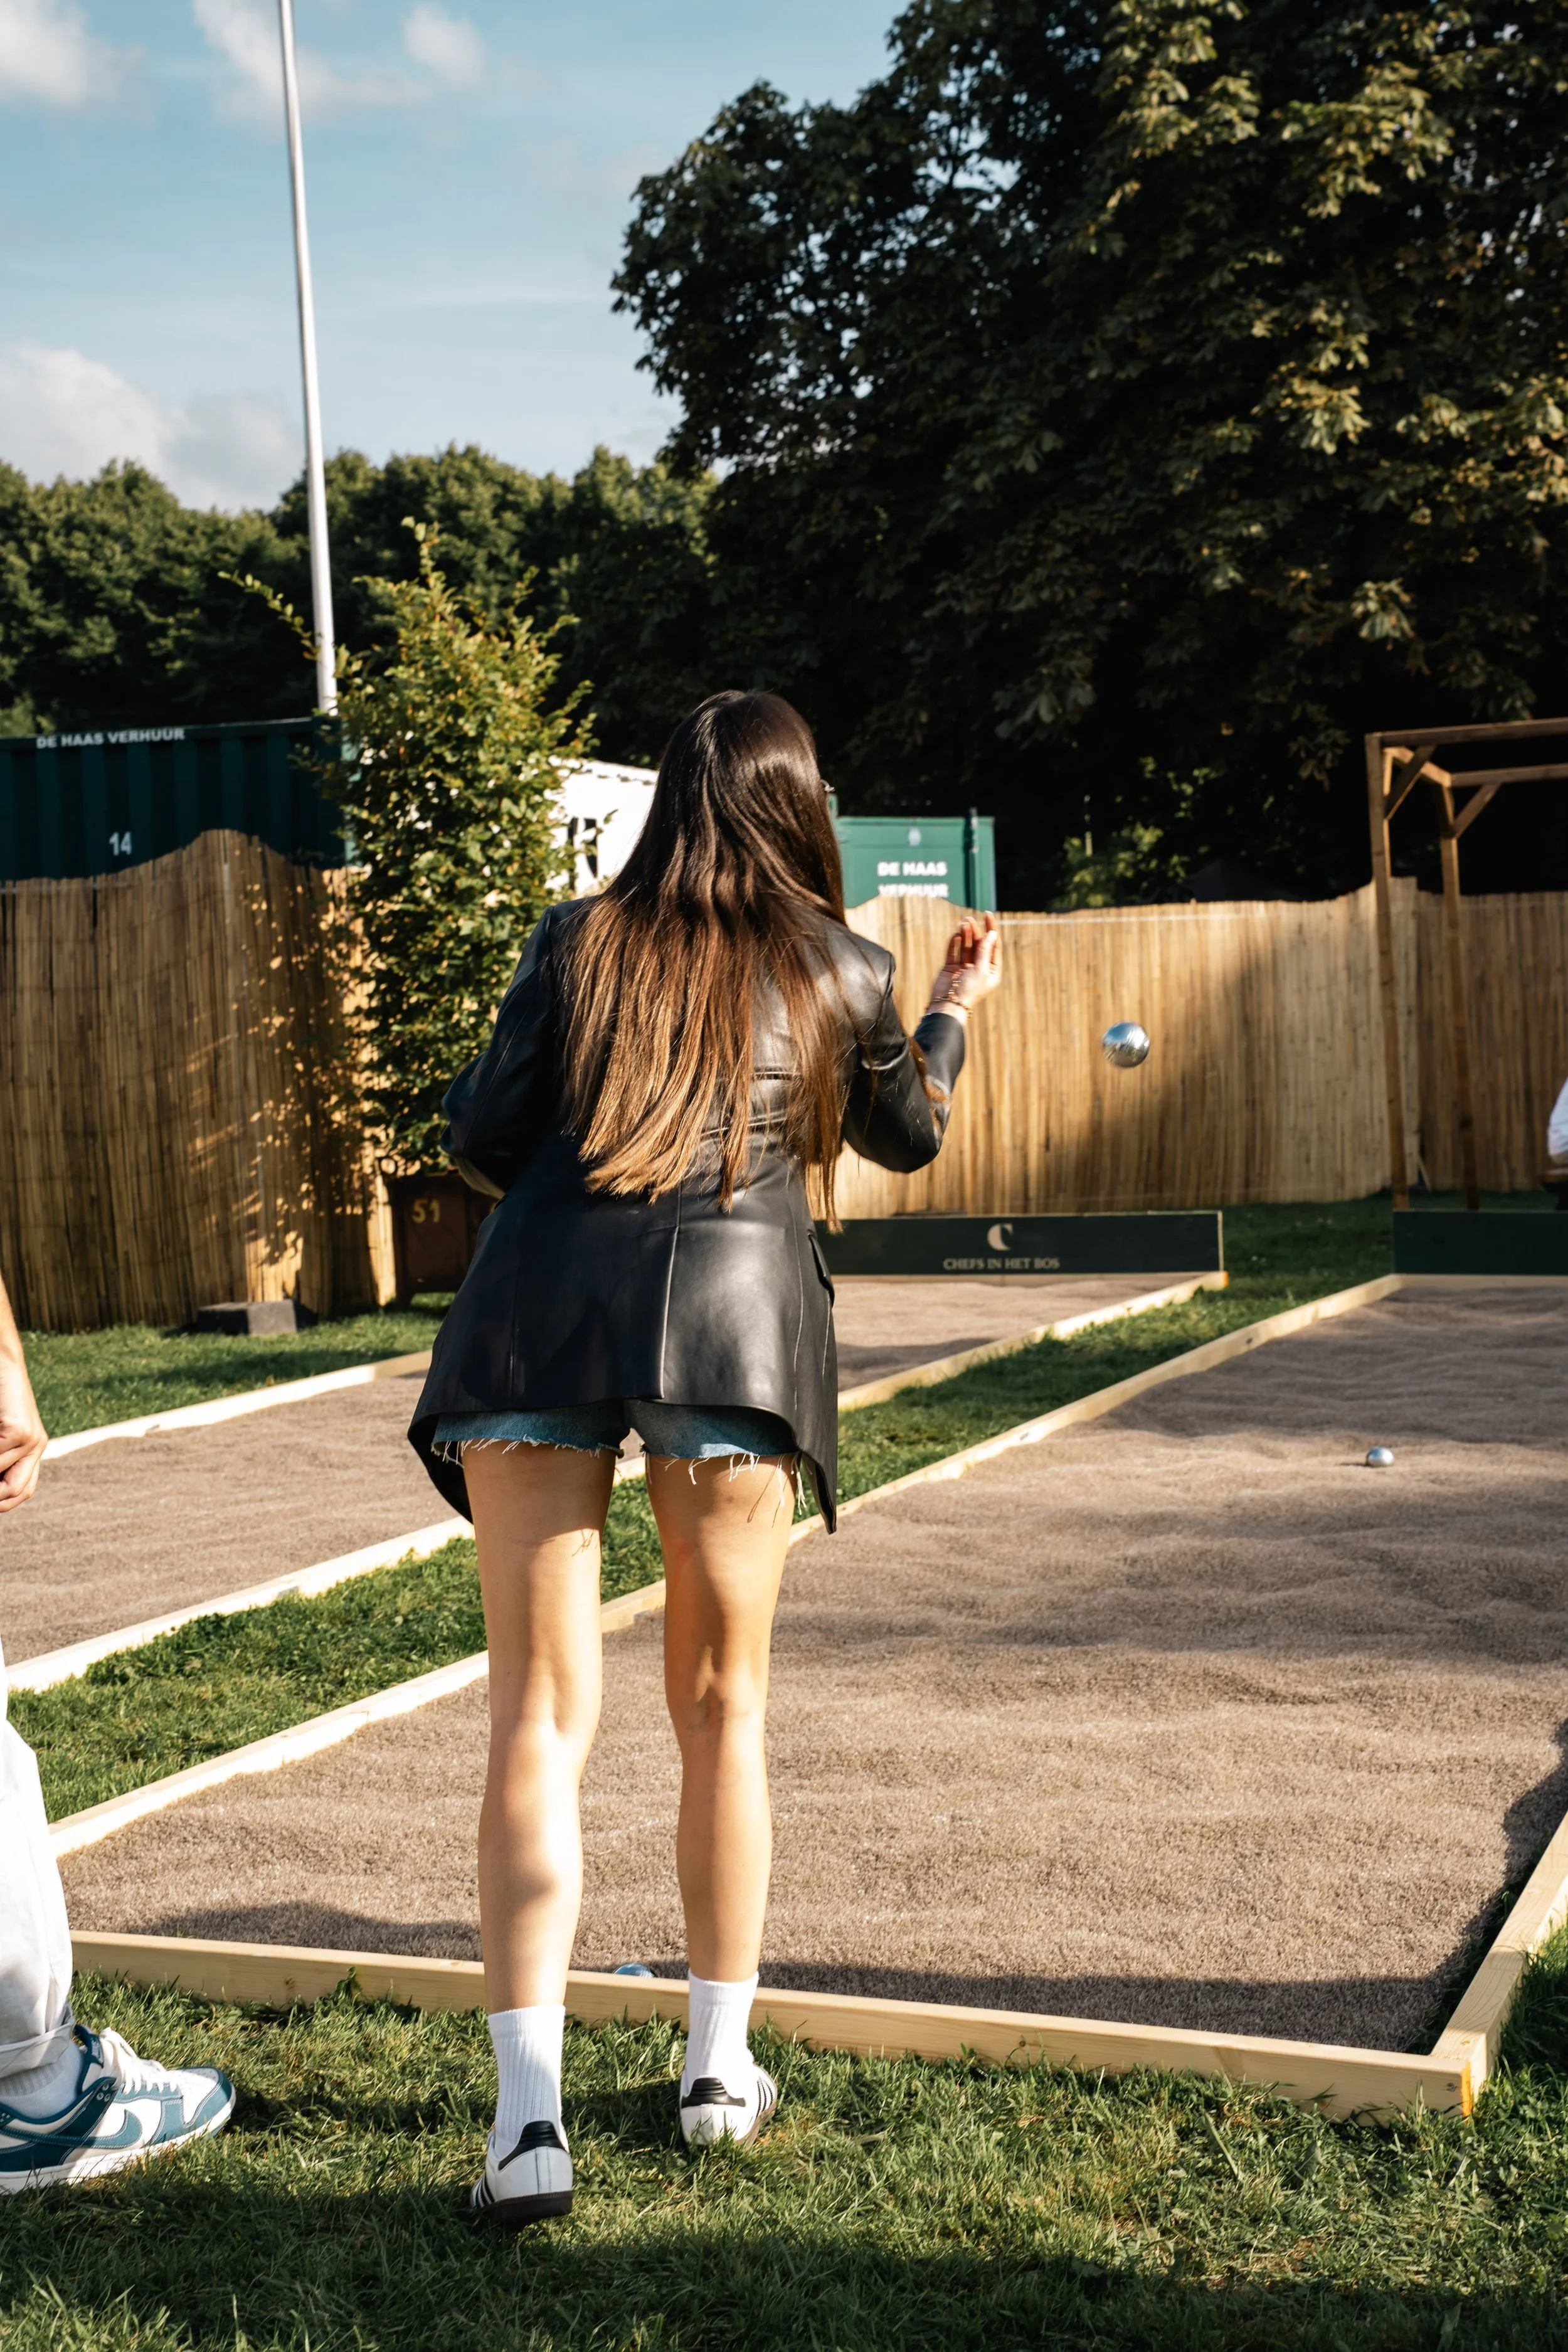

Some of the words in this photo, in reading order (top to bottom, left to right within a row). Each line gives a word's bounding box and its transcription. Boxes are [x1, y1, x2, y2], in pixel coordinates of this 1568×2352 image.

[36, 736, 57, 748] DE
[61, 733, 103, 747] HAAS
[108, 728, 185, 744] VERHUUR
[109, 832, 132, 856] 14
[877, 862, 900, 876] DE
[903, 861, 948, 876] HAAS
[411, 1198, 440, 1223] 51
[943, 1258, 984, 1270] CHEFS
[987, 1258, 1002, 1269] IN
[1005, 1258, 1032, 1269] HET
[1034, 1257, 1061, 1269] BOS
